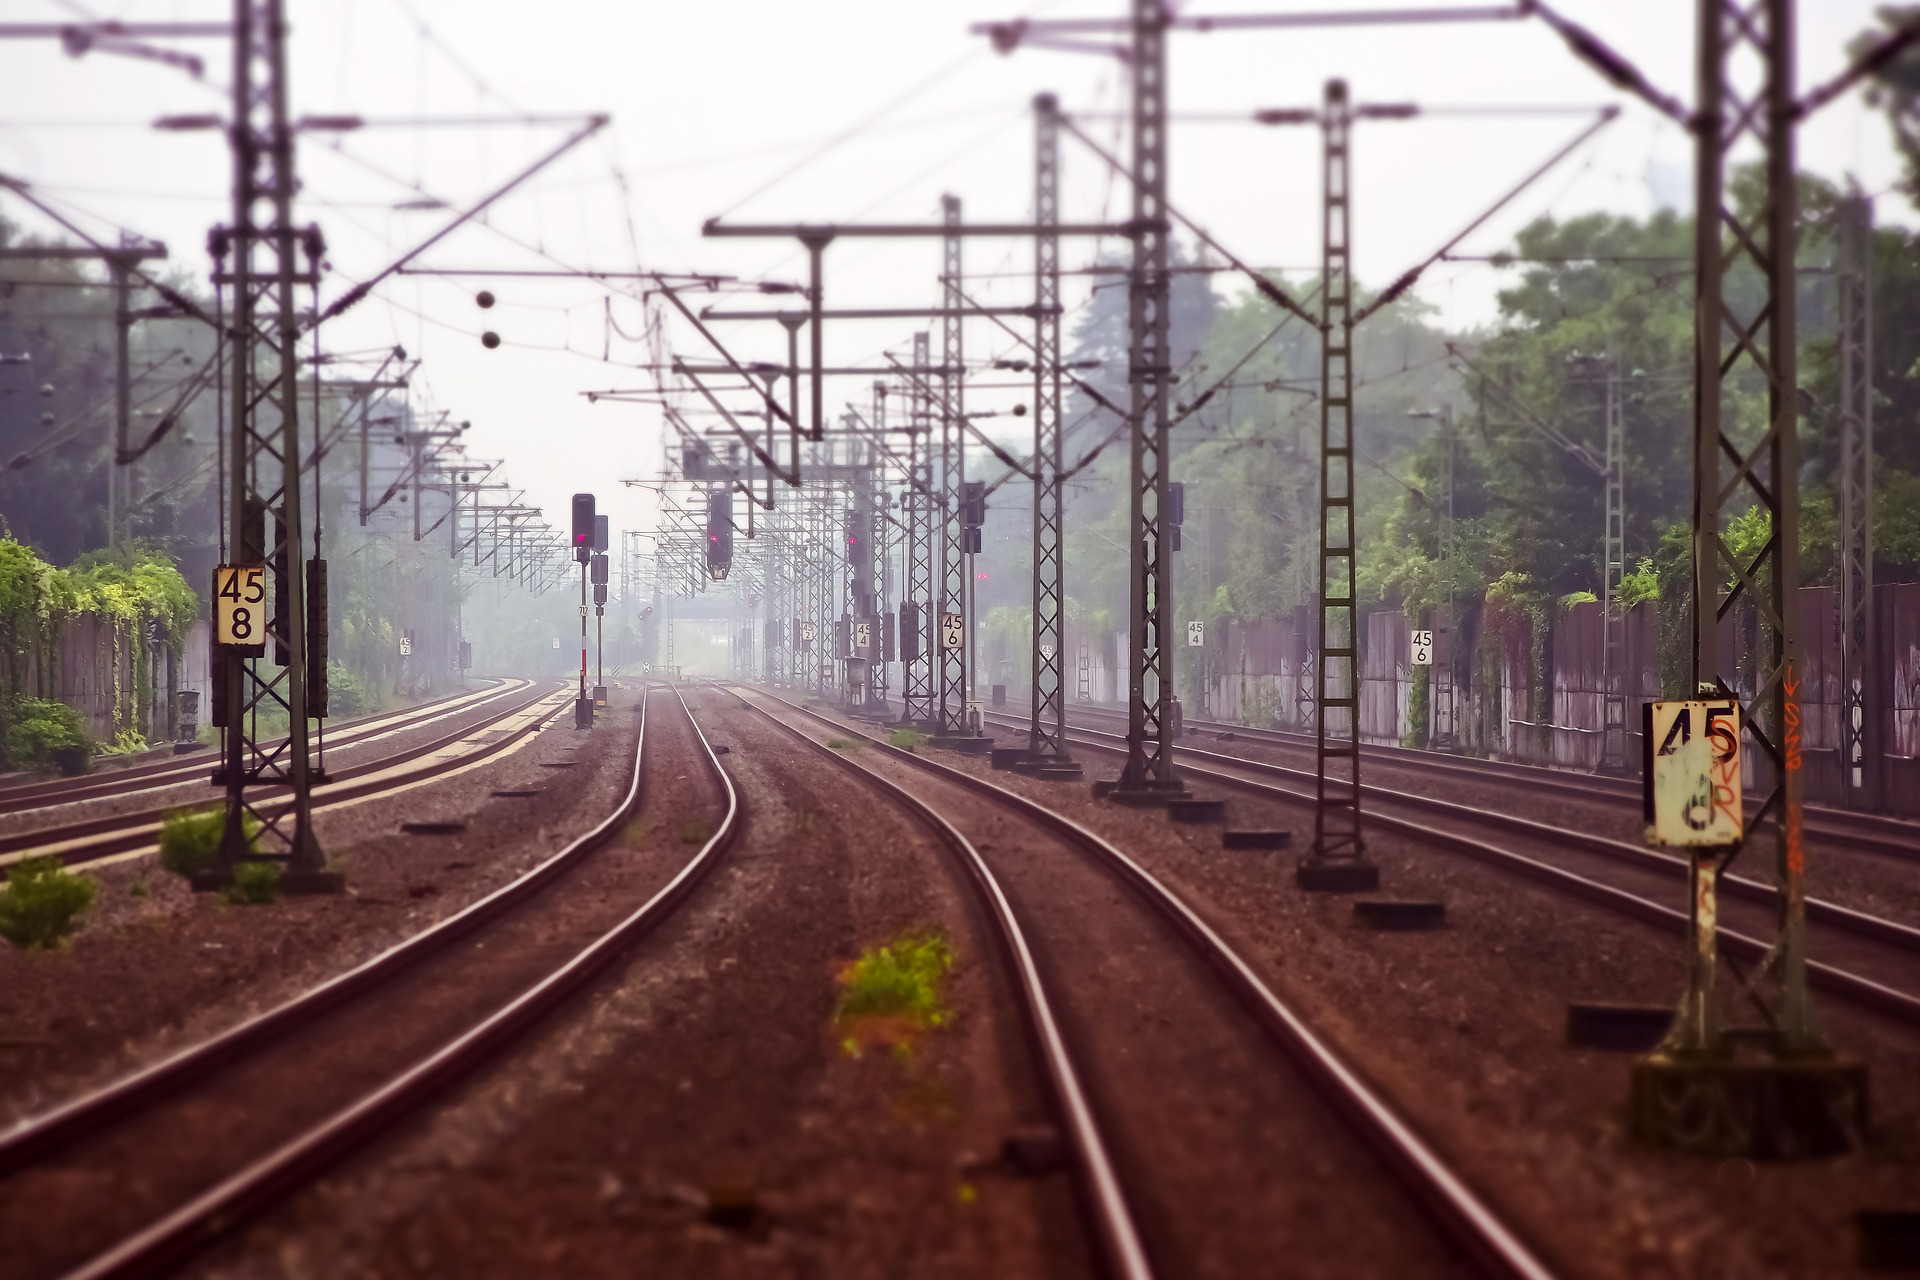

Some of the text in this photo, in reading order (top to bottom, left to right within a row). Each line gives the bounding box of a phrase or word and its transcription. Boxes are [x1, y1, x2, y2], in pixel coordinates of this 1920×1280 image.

[219, 571, 264, 604] 45
[579, 606, 589, 615] 712
[231, 607, 252, 640] 8
[943, 615, 963, 630] 45
[1189, 623, 1203, 633] 45
[805, 631, 811, 639] 2
[860, 635, 867, 645] 4
[948, 631, 958, 645] 6
[1192, 634, 1200, 644] 4
[1412, 632, 1432, 646] 45
[400, 638, 411, 646] 45
[1417, 648, 1427, 662] 6
